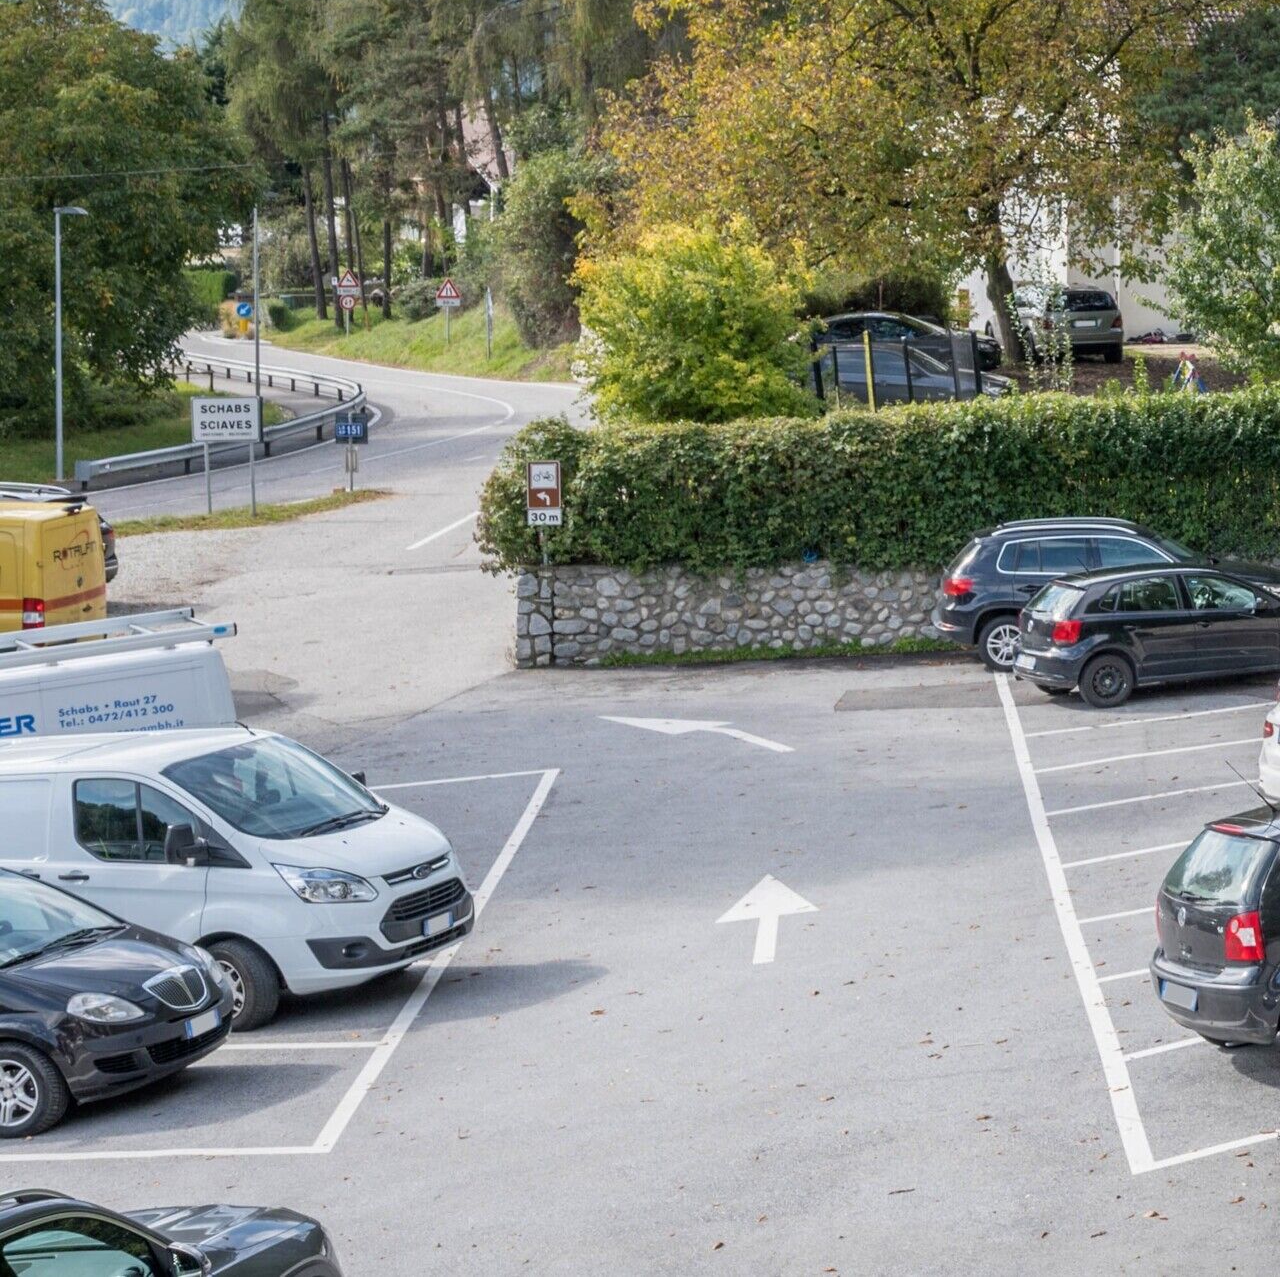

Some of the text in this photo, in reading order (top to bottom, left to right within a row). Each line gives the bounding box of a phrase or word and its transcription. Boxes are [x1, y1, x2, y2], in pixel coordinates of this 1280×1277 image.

[200, 404, 251, 414] SCHABS
[200, 420, 252, 430] SCIAVES
[347, 425, 361, 435] 151
[530, 512, 547, 522] 30
[58, 695, 157, 717] Schabs Raut 27
[59, 703, 174, 728] Tel.: 0472/412 300
